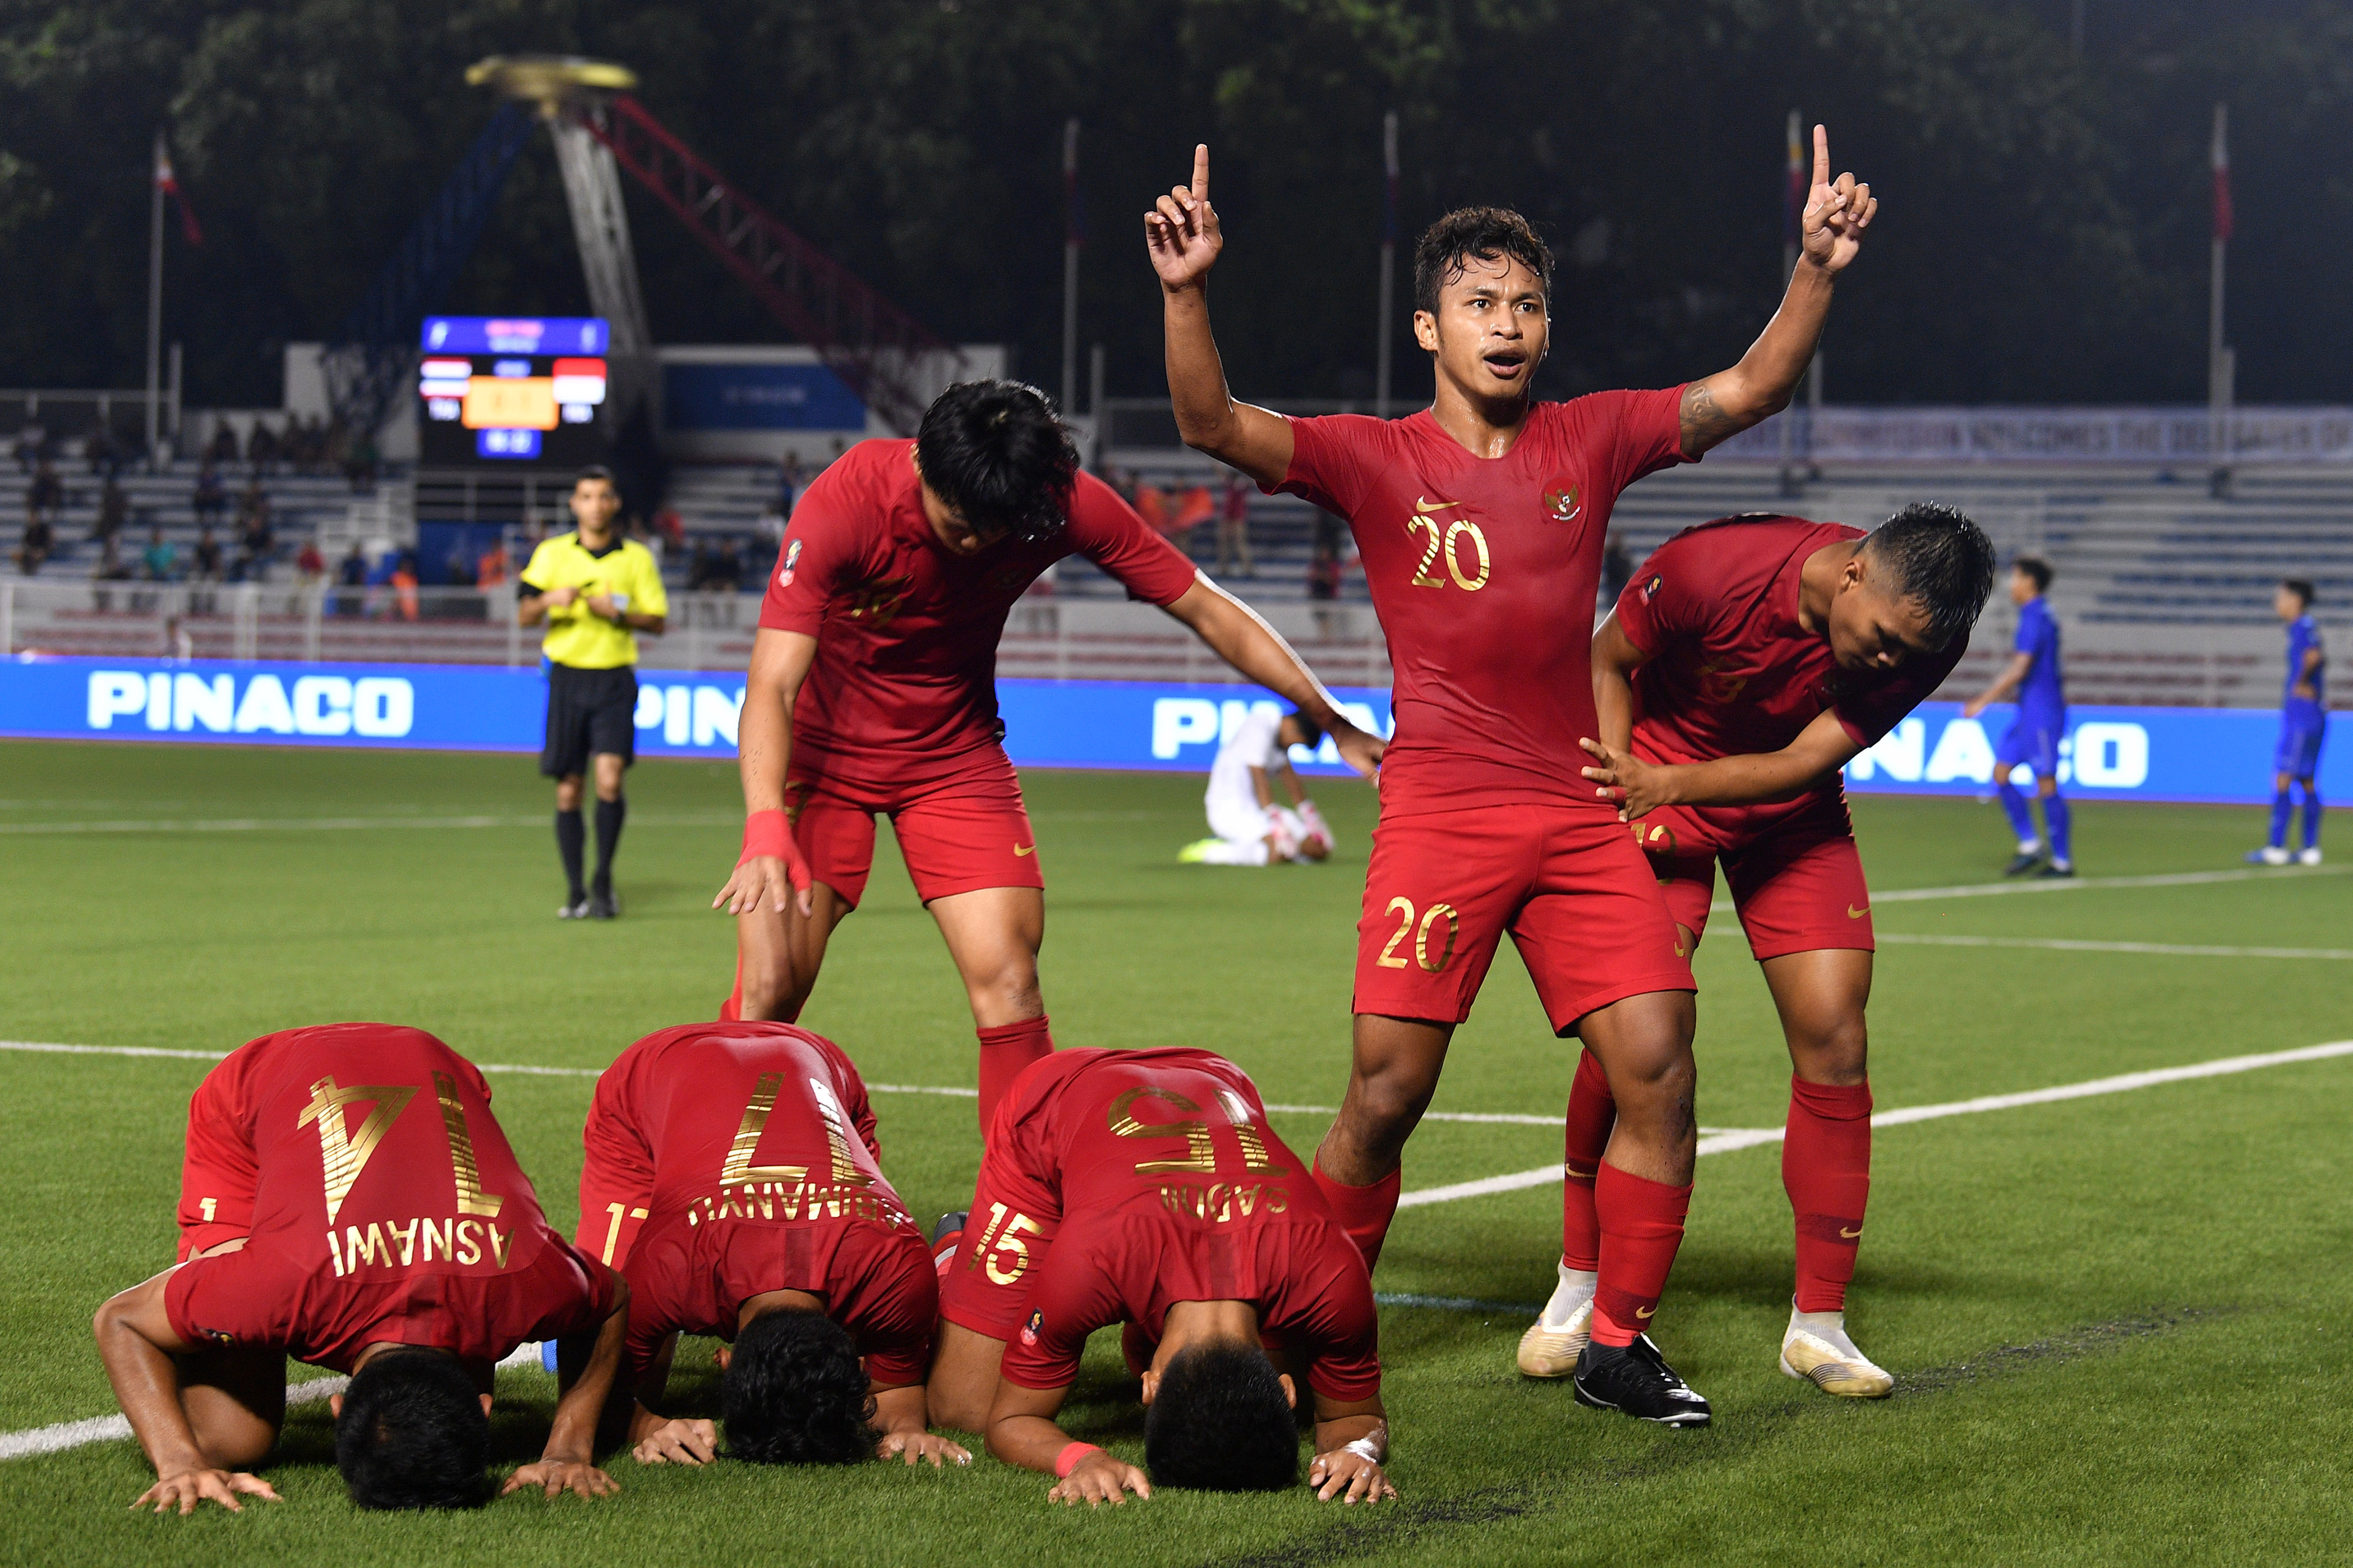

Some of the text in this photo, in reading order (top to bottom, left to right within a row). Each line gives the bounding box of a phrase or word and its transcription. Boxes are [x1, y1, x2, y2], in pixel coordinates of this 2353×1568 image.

[1407, 515, 1491, 591] 20
[88, 670, 414, 737] PINACO
[634, 684, 745, 746] PIN
[1375, 896, 1459, 973] 20
[297, 1070, 504, 1226] 14
[719, 1072, 876, 1189] 17
[1107, 1086, 1290, 1177] 15
[326, 1217, 515, 1277] ASNAWI
[967, 1201, 1045, 1286] 15
